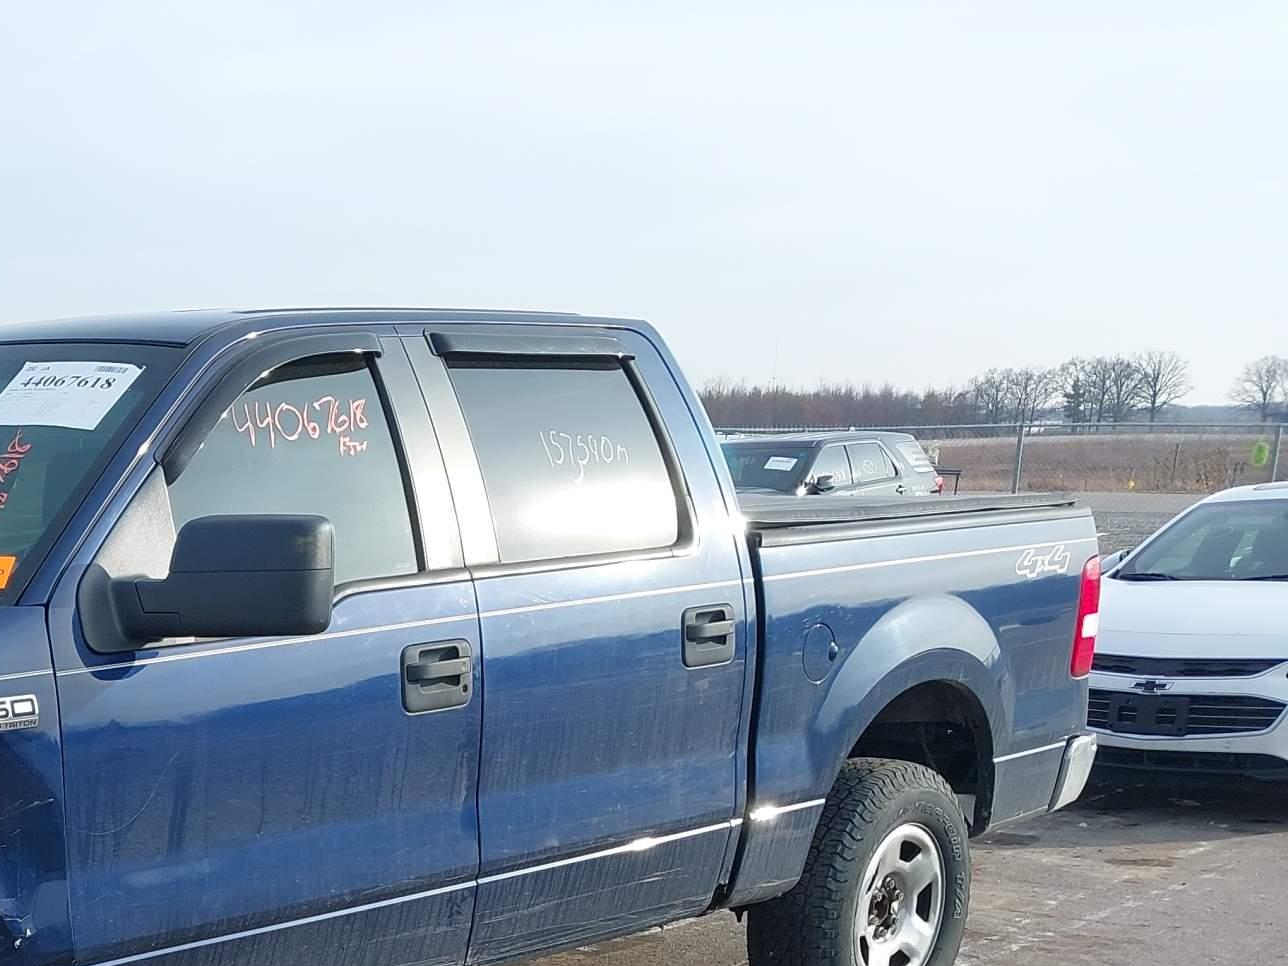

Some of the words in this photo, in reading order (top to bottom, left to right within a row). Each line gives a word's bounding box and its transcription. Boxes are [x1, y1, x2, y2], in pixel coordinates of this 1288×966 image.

[20, 375, 116, 390] 44067618
[231, 396, 369, 449] 44067618
[1015, 544, 1070, 578] 4x4
